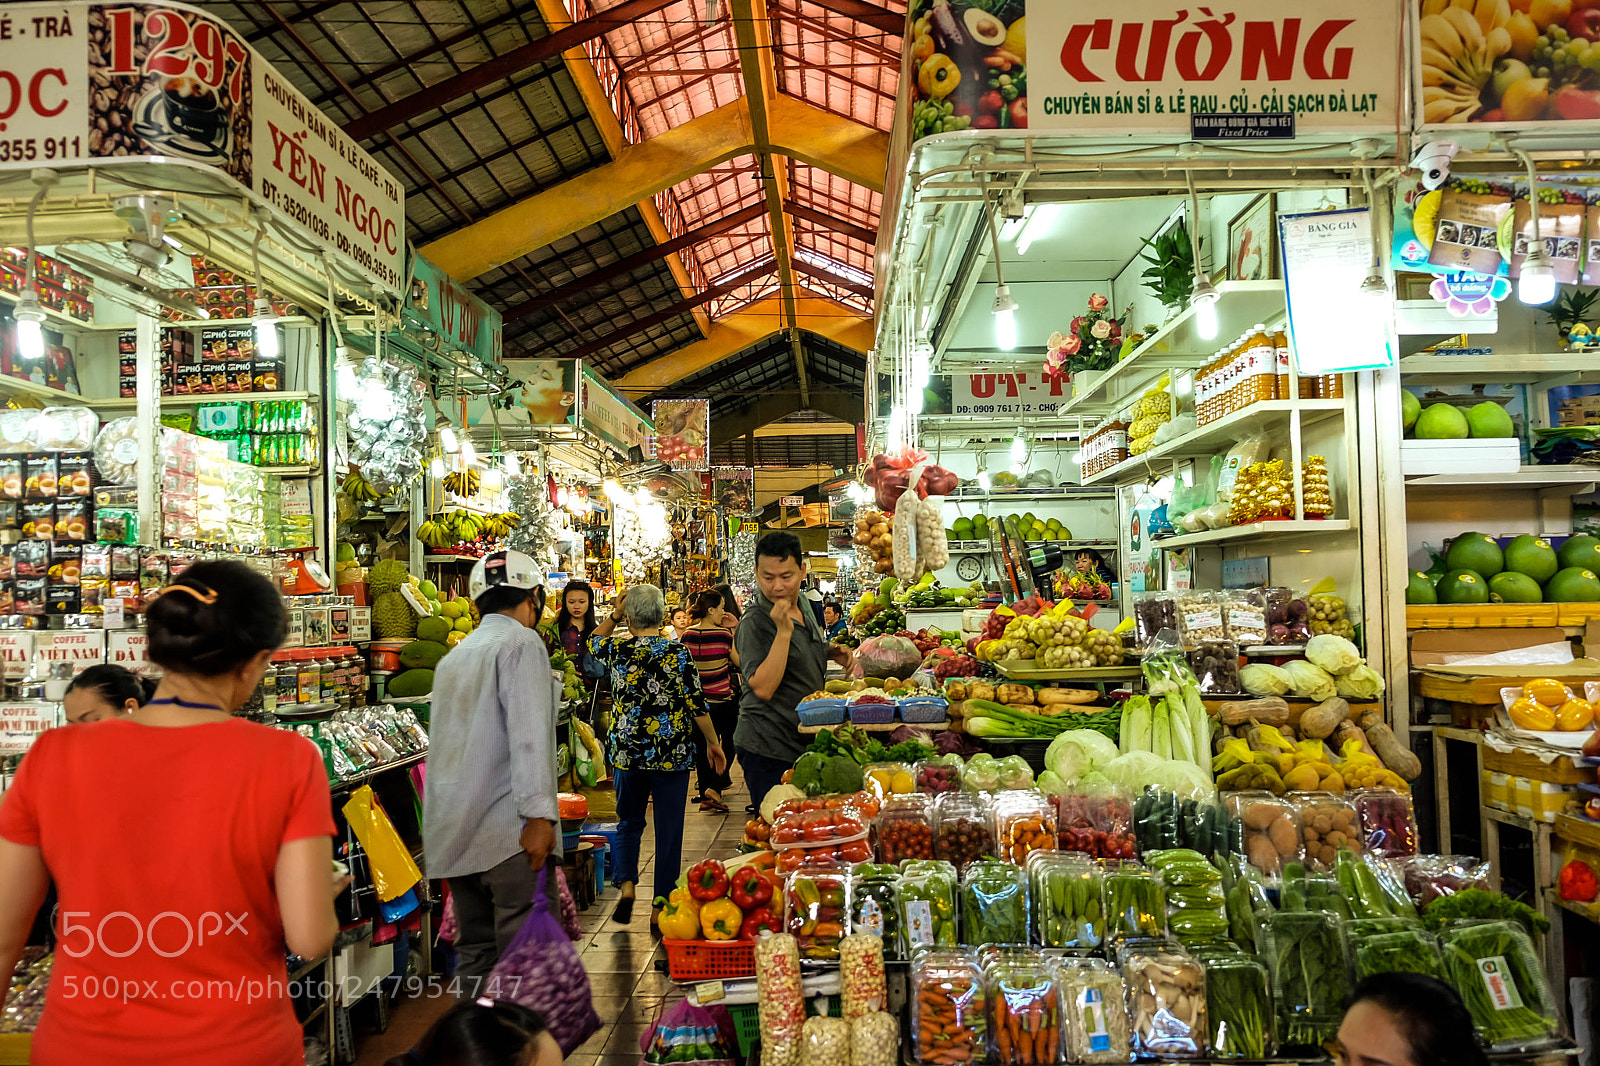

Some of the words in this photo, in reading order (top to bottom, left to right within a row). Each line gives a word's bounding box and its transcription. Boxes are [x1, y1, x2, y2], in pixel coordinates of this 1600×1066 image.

[32, 10, 73, 38] TRÀ
[1060, 6, 1357, 82] CƯỜNG
[105, 7, 247, 107] 1297
[1044, 92, 1101, 115] CHUYÊN
[1105, 90, 1132, 114] BÁN
[1138, 88, 1152, 114] SỈ
[1154, 96, 1164, 114] &
[1170, 88, 1186, 114] LẺ
[1190, 94, 1218, 114] RAU
[1230, 88, 1248, 114] CỦ
[1261, 86, 1282, 114] CẢI
[1288, 94, 1324, 118] SẠCH
[1328, 88, 1347, 112] ĐÀ
[1352, 93, 1378, 116] LẠT
[264, 73, 306, 125] CHUYÊN
[308, 112, 327, 141] BÁN
[328, 127, 338, 153] SỈ
[339, 140, 345, 158] &
[348, 144, 358, 170] LẺ
[360, 158, 379, 188] CAFÉ
[384, 178, 398, 204] TRÀ
[1218, 128, 1243, 136] Fixed
[1246, 128, 1269, 136] Price
[44, 136, 80, 160] 911
[267, 120, 326, 204] YẾN
[334, 175, 398, 256] NGỌC
[262, 177, 281, 207] ĐT:
[283, 194, 329, 242] 35201036
[336, 230, 352, 257] DĐ:
[388, 264, 401, 291] 911
[1338, 218, 1358, 230] GIÁ
[956, 406, 972, 414] DĐ:
[973, 405, 995, 413] 0909
[996, 404, 1012, 412] 761
[1038, 403, 1058, 413] CHỢ:
[53, 636, 86, 644] COFFEE
[72, 648, 100, 660] NAM
[115, 648, 136, 662] ĐÀ
[2, 708, 38, 716] COFFEE
